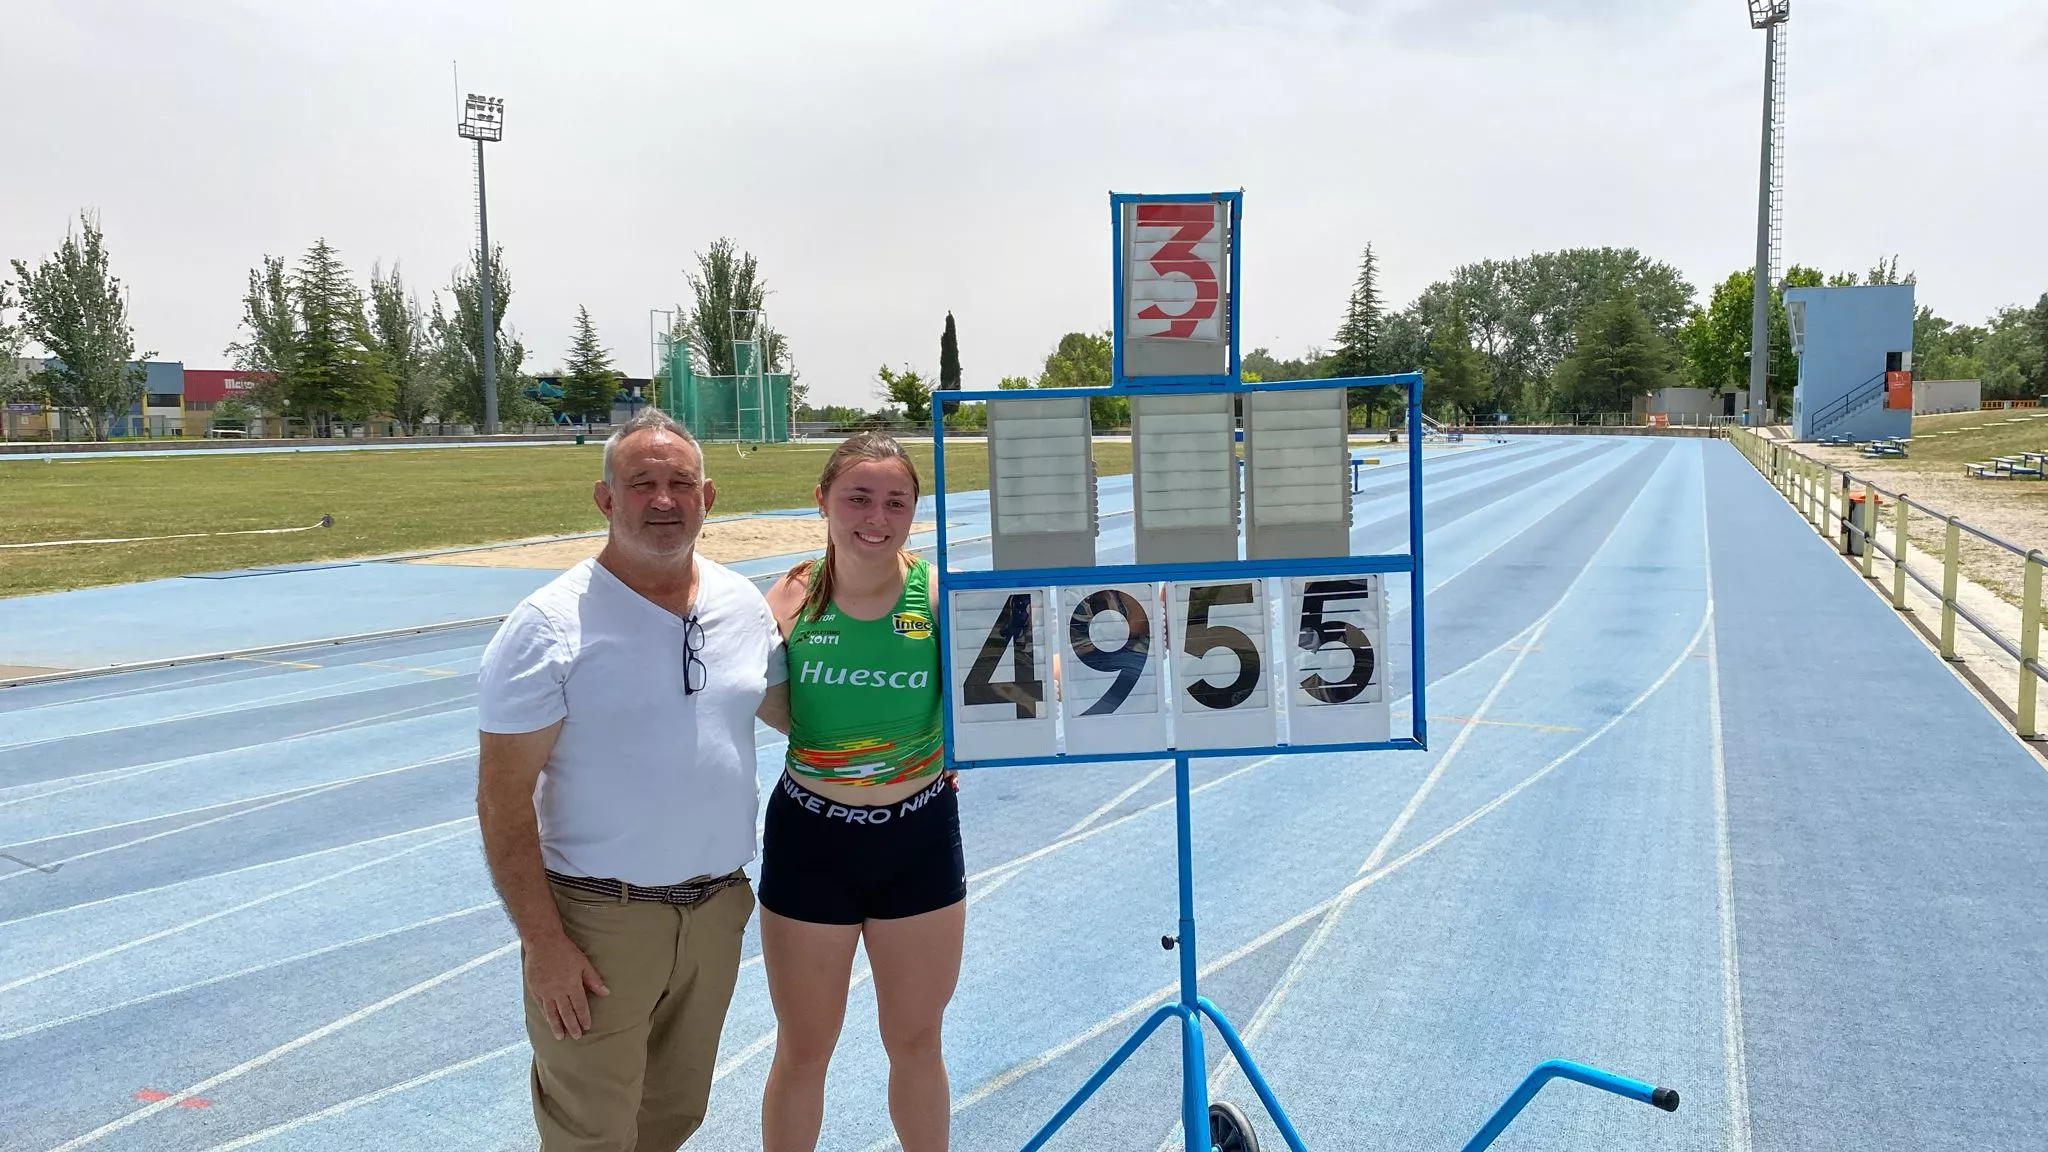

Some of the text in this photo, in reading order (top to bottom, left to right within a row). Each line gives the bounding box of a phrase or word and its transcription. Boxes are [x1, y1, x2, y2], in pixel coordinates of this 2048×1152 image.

[1136, 204, 1219, 339] 3
[800, 660, 929, 689] Huesca
[781, 773, 826, 814] NIKE
[826, 806, 892, 825] PRO
